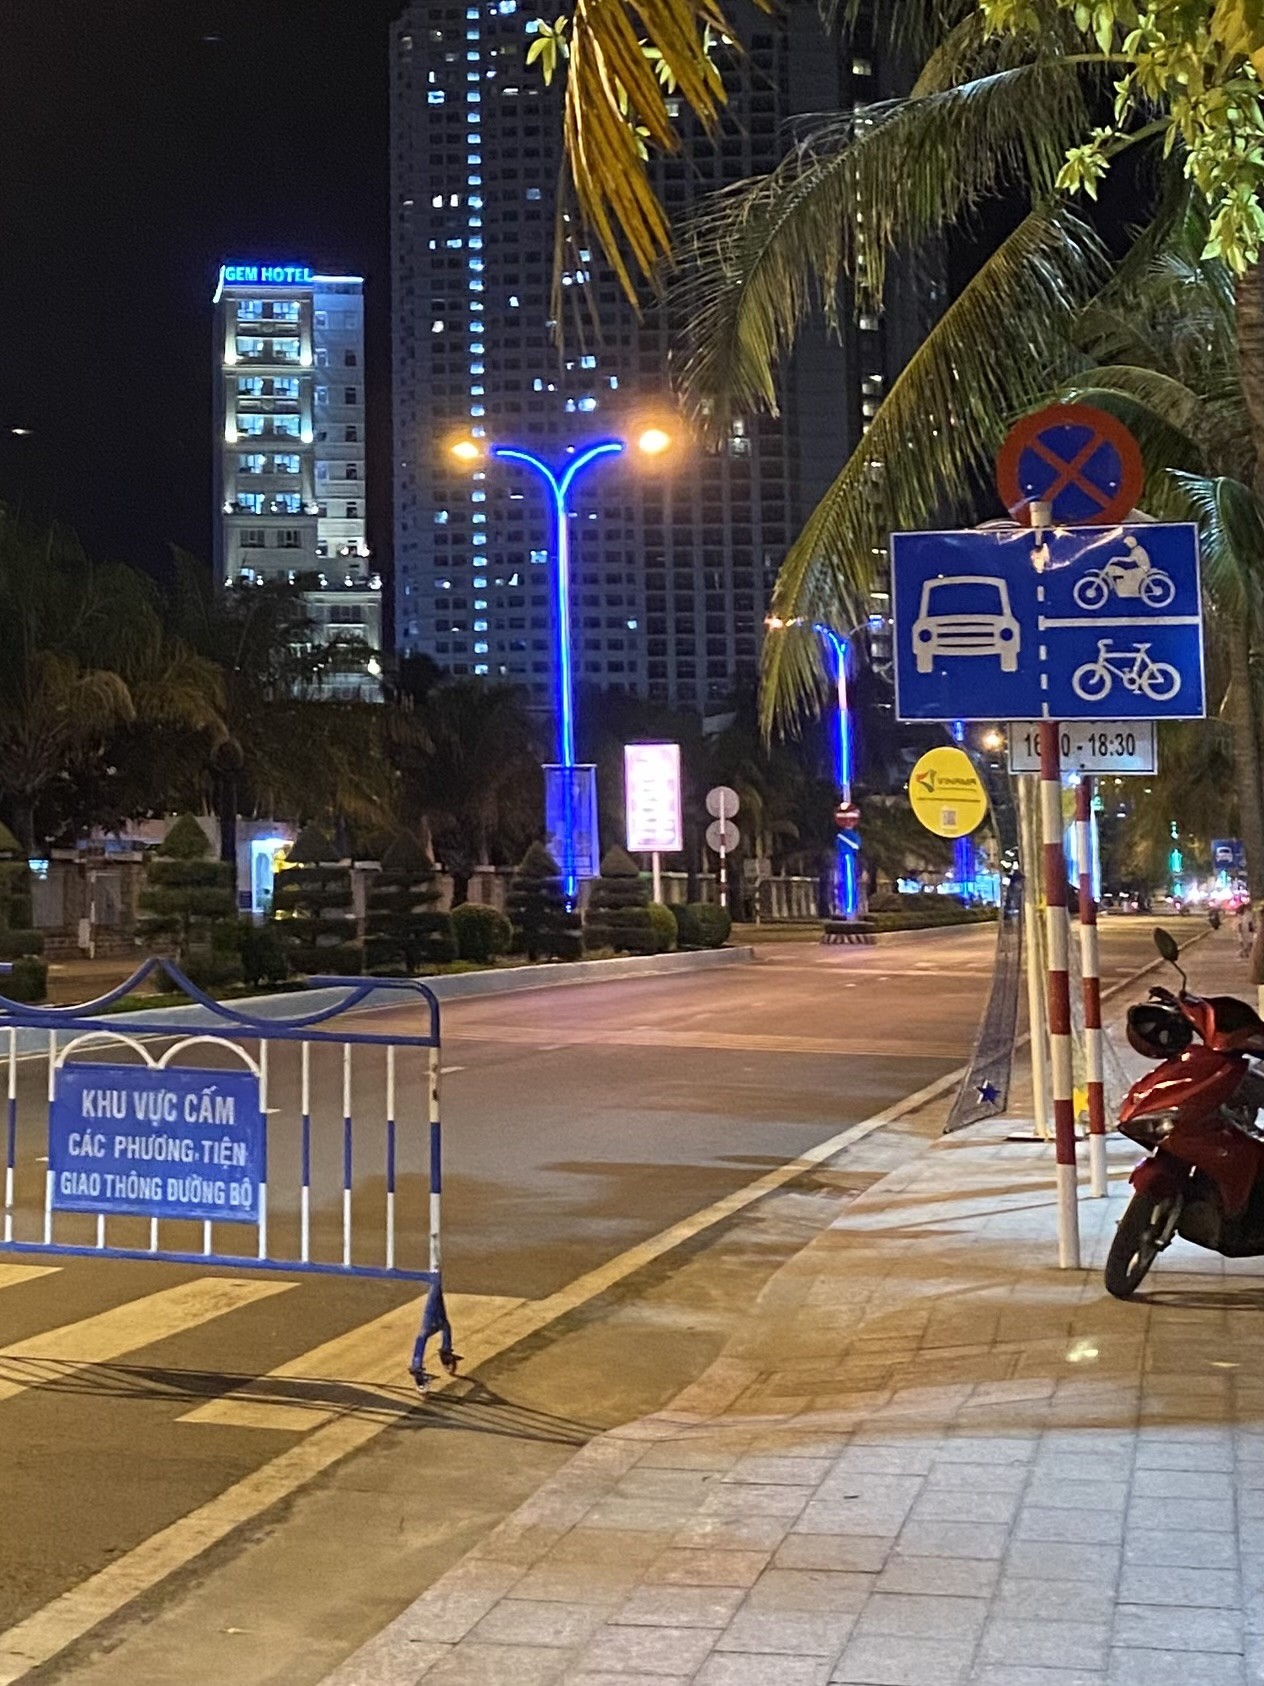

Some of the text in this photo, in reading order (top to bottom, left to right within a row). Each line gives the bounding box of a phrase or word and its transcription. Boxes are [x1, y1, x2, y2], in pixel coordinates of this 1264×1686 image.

[225, 266, 313, 282] GEM HOTEL
[1024, 733, 1070, 757] 160
[1088, 733, 1136, 757] 18:30
[82, 1085, 235, 1127] KHU VỰC CẤM
[68, 1128, 247, 1169] CÁC PHƯƠNG TIỆN
[60, 1170, 253, 1211] GIAO THÔNG ĐƯỜNG BỘ
